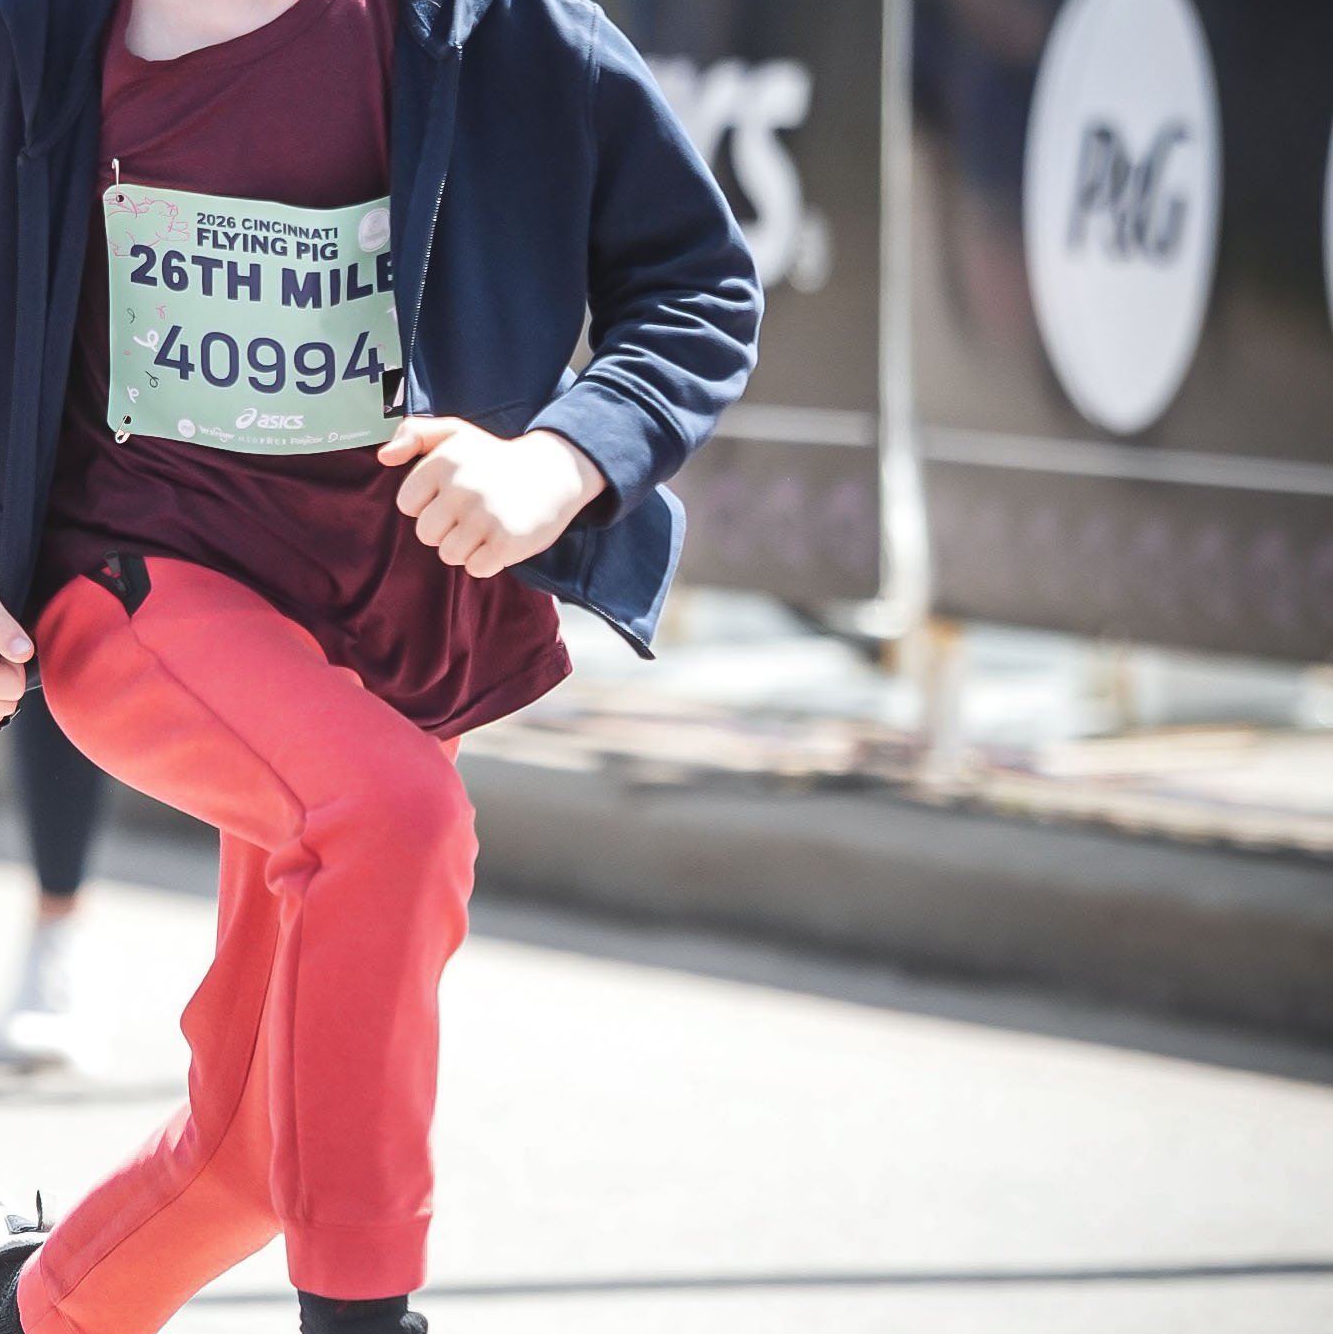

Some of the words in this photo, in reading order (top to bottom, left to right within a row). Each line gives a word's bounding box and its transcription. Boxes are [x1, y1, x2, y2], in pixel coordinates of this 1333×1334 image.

[196, 212, 236, 229] 2026
[241, 217, 339, 240] CINCINNATI
[196, 228, 288, 257] FLYING
[296, 240, 339, 262] PIG
[130, 244, 261, 302] 26TH
[281, 251, 395, 309] MILE
[153, 324, 385, 395] 40994
